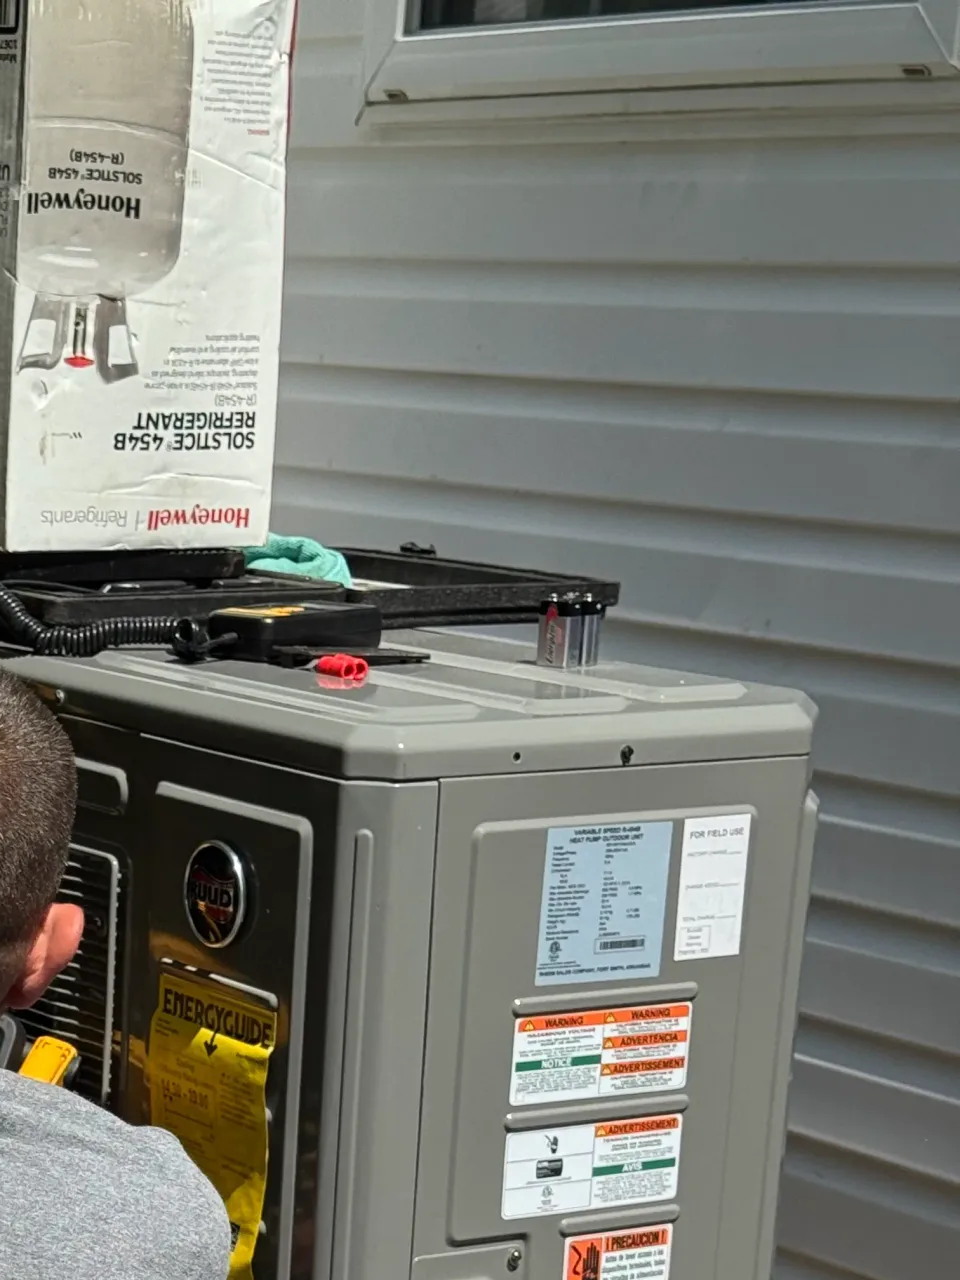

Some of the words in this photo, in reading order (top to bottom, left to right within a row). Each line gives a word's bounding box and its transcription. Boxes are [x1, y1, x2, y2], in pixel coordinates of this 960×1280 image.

[69, 149, 124, 165] (R-454B)
[48, 168, 79, 179] 454B
[27, 189, 141, 219] Honeywell
[214, 394, 257, 406] (R-454B)
[132, 412, 256, 429] REFRIGERANT
[113, 433, 163, 450] 454B
[40, 504, 128, 529] Refrigerants
[147, 504, 250, 531] Honeywell
[690, 831, 705, 840] FOR
[707, 829, 728, 839] FIELD
[729, 827, 744, 836] USE
[191, 882, 232, 908] RUUD
[162, 988, 273, 1048] ENERGYGUIDE
[544, 1016, 584, 1028] WARNING
[631, 1008, 671, 1020] WARNING
[620, 1033, 678, 1046] ADVERTENCIA
[541, 1057, 572, 1068] NOTICE
[612, 1059, 685, 1073] ADVERTISSEMENT
[608, 1118, 678, 1134] ADVERTISSEMENT
